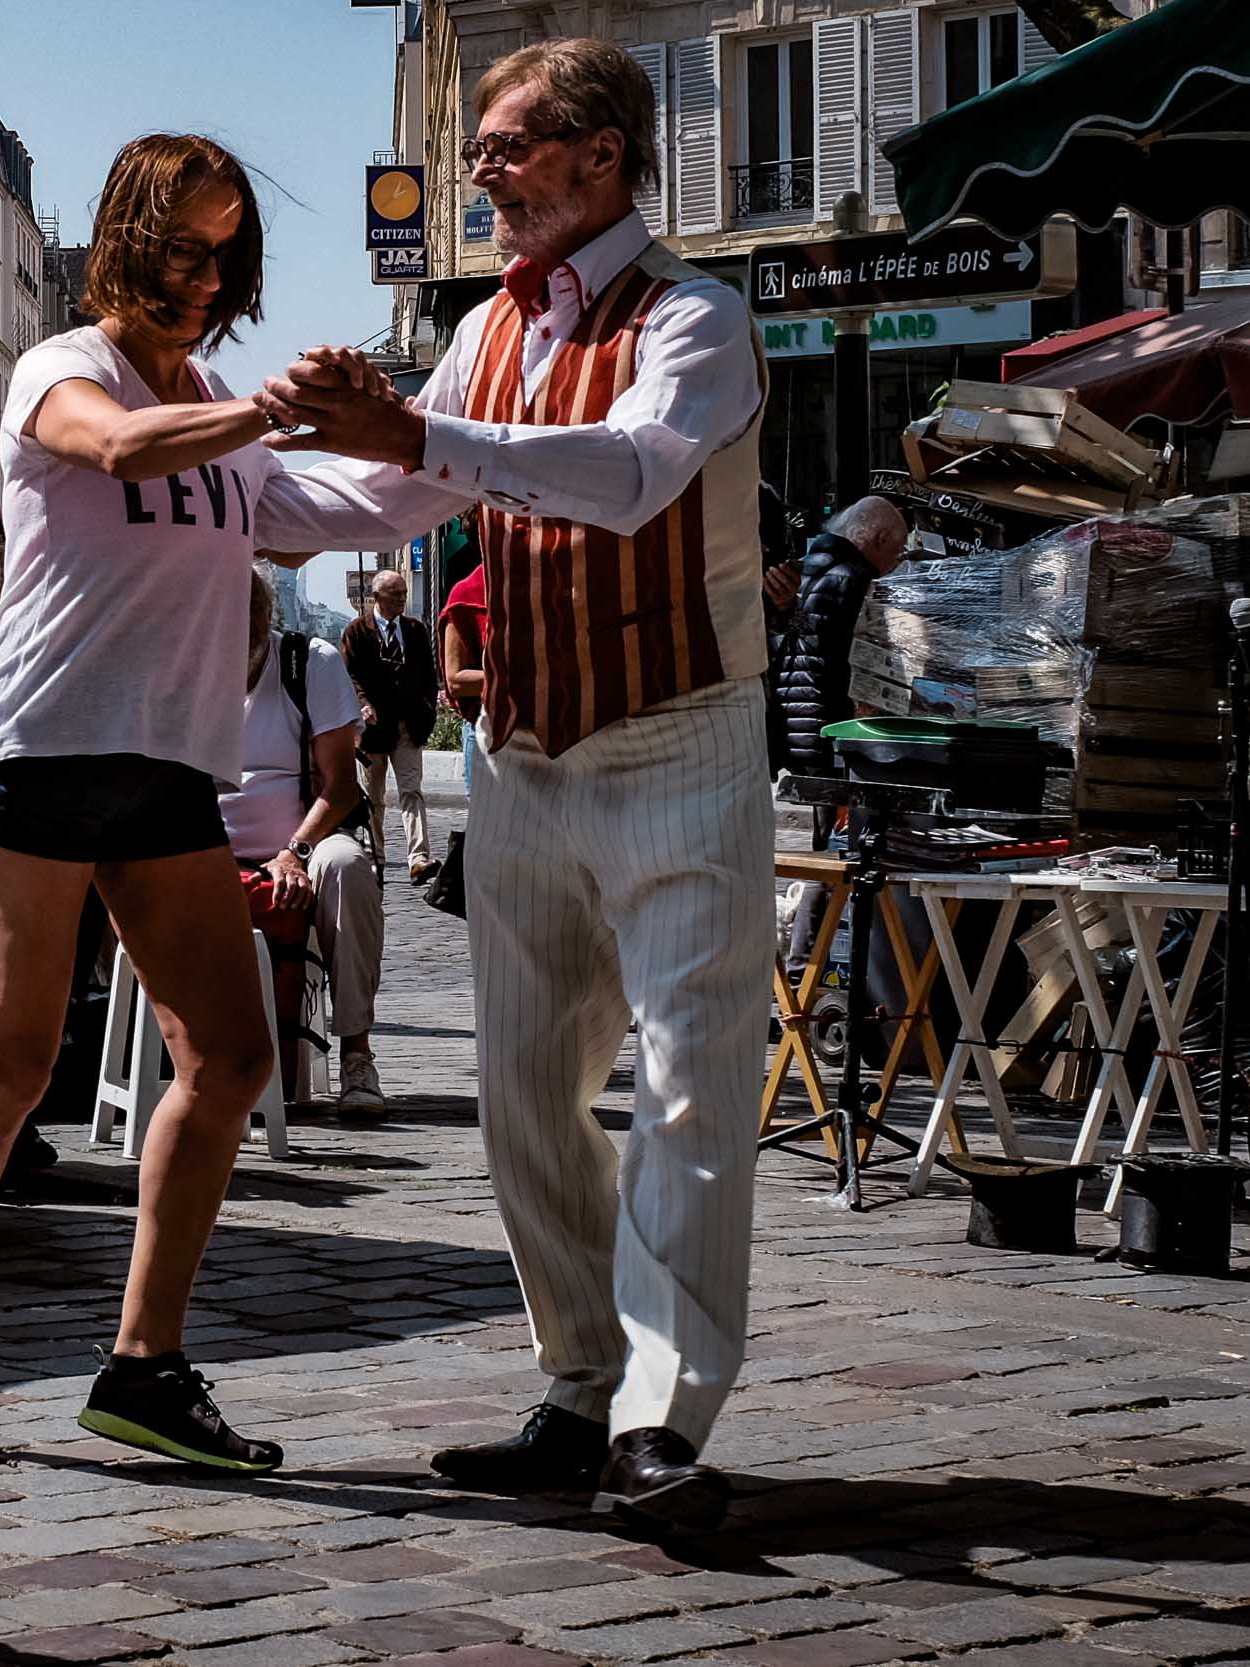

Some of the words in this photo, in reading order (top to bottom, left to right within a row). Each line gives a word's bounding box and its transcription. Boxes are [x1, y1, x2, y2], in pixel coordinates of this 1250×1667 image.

[370, 228, 422, 241] CITIZEN
[380, 250, 425, 266] JAZ
[380, 265, 425, 275] QUARTZ
[791, 265, 853, 289] cinéma
[858, 252, 918, 282] L'ÉPÉE
[922, 261, 941, 277] DE
[946, 249, 991, 274] BOIS
